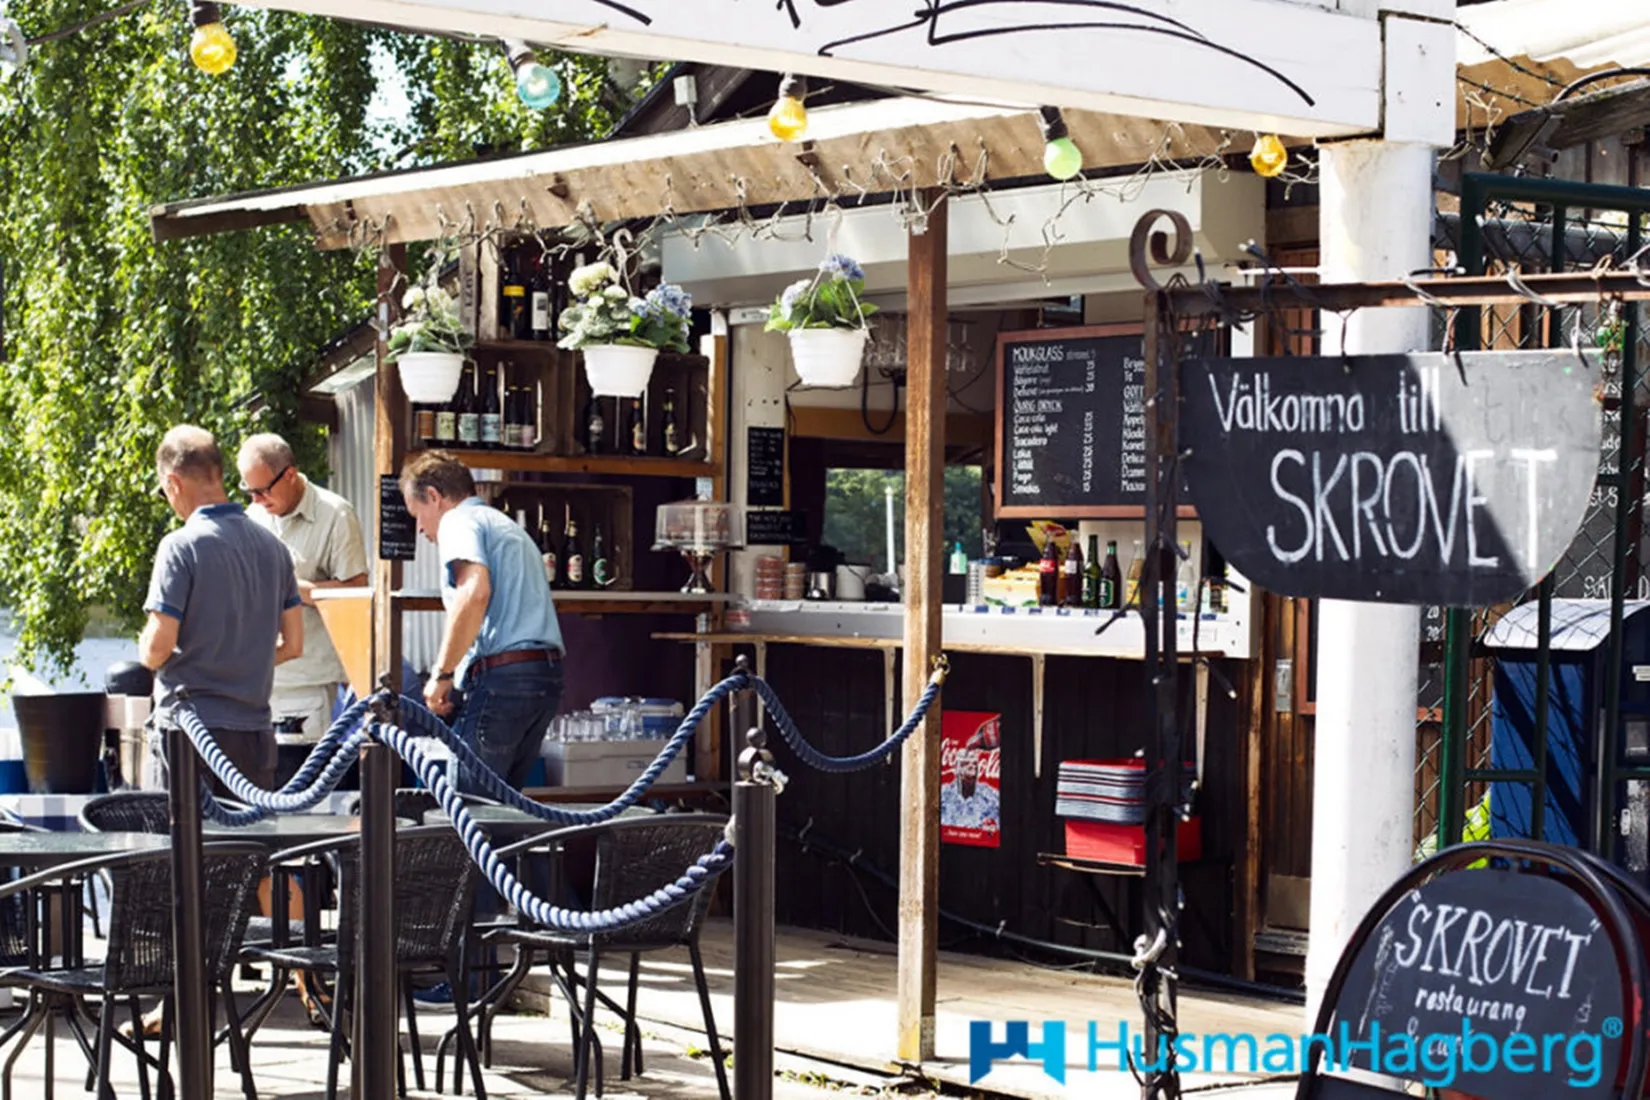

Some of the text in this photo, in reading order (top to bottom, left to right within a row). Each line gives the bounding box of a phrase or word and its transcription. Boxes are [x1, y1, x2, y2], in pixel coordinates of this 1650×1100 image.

[1208, 366, 1441, 433] Välkomna till
[1266, 448, 1557, 568] SKROVET
[1414, 984, 1526, 1037] restaurang
